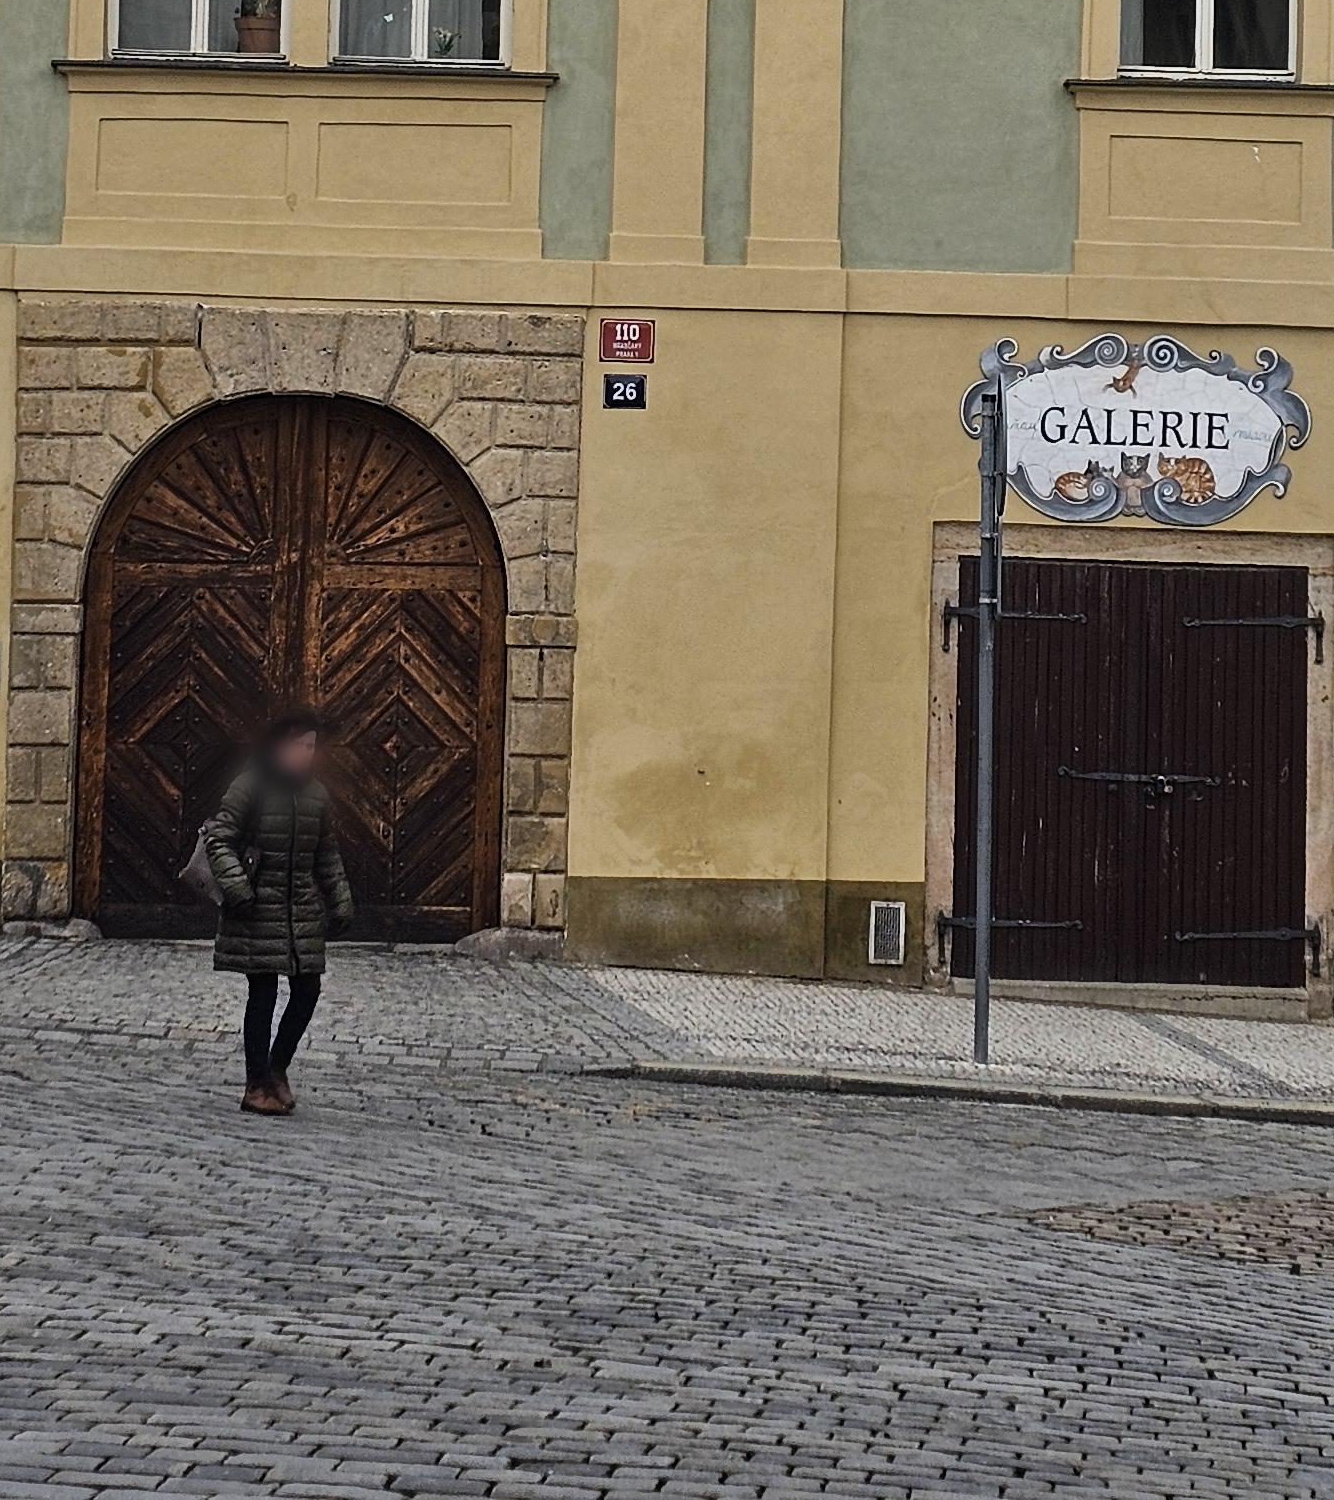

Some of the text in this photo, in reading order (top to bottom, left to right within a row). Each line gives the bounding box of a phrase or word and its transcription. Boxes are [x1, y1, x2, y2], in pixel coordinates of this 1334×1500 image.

[615, 323, 640, 341] 110
[612, 382, 637, 401] 26
[1040, 406, 1230, 450] GALERIE
